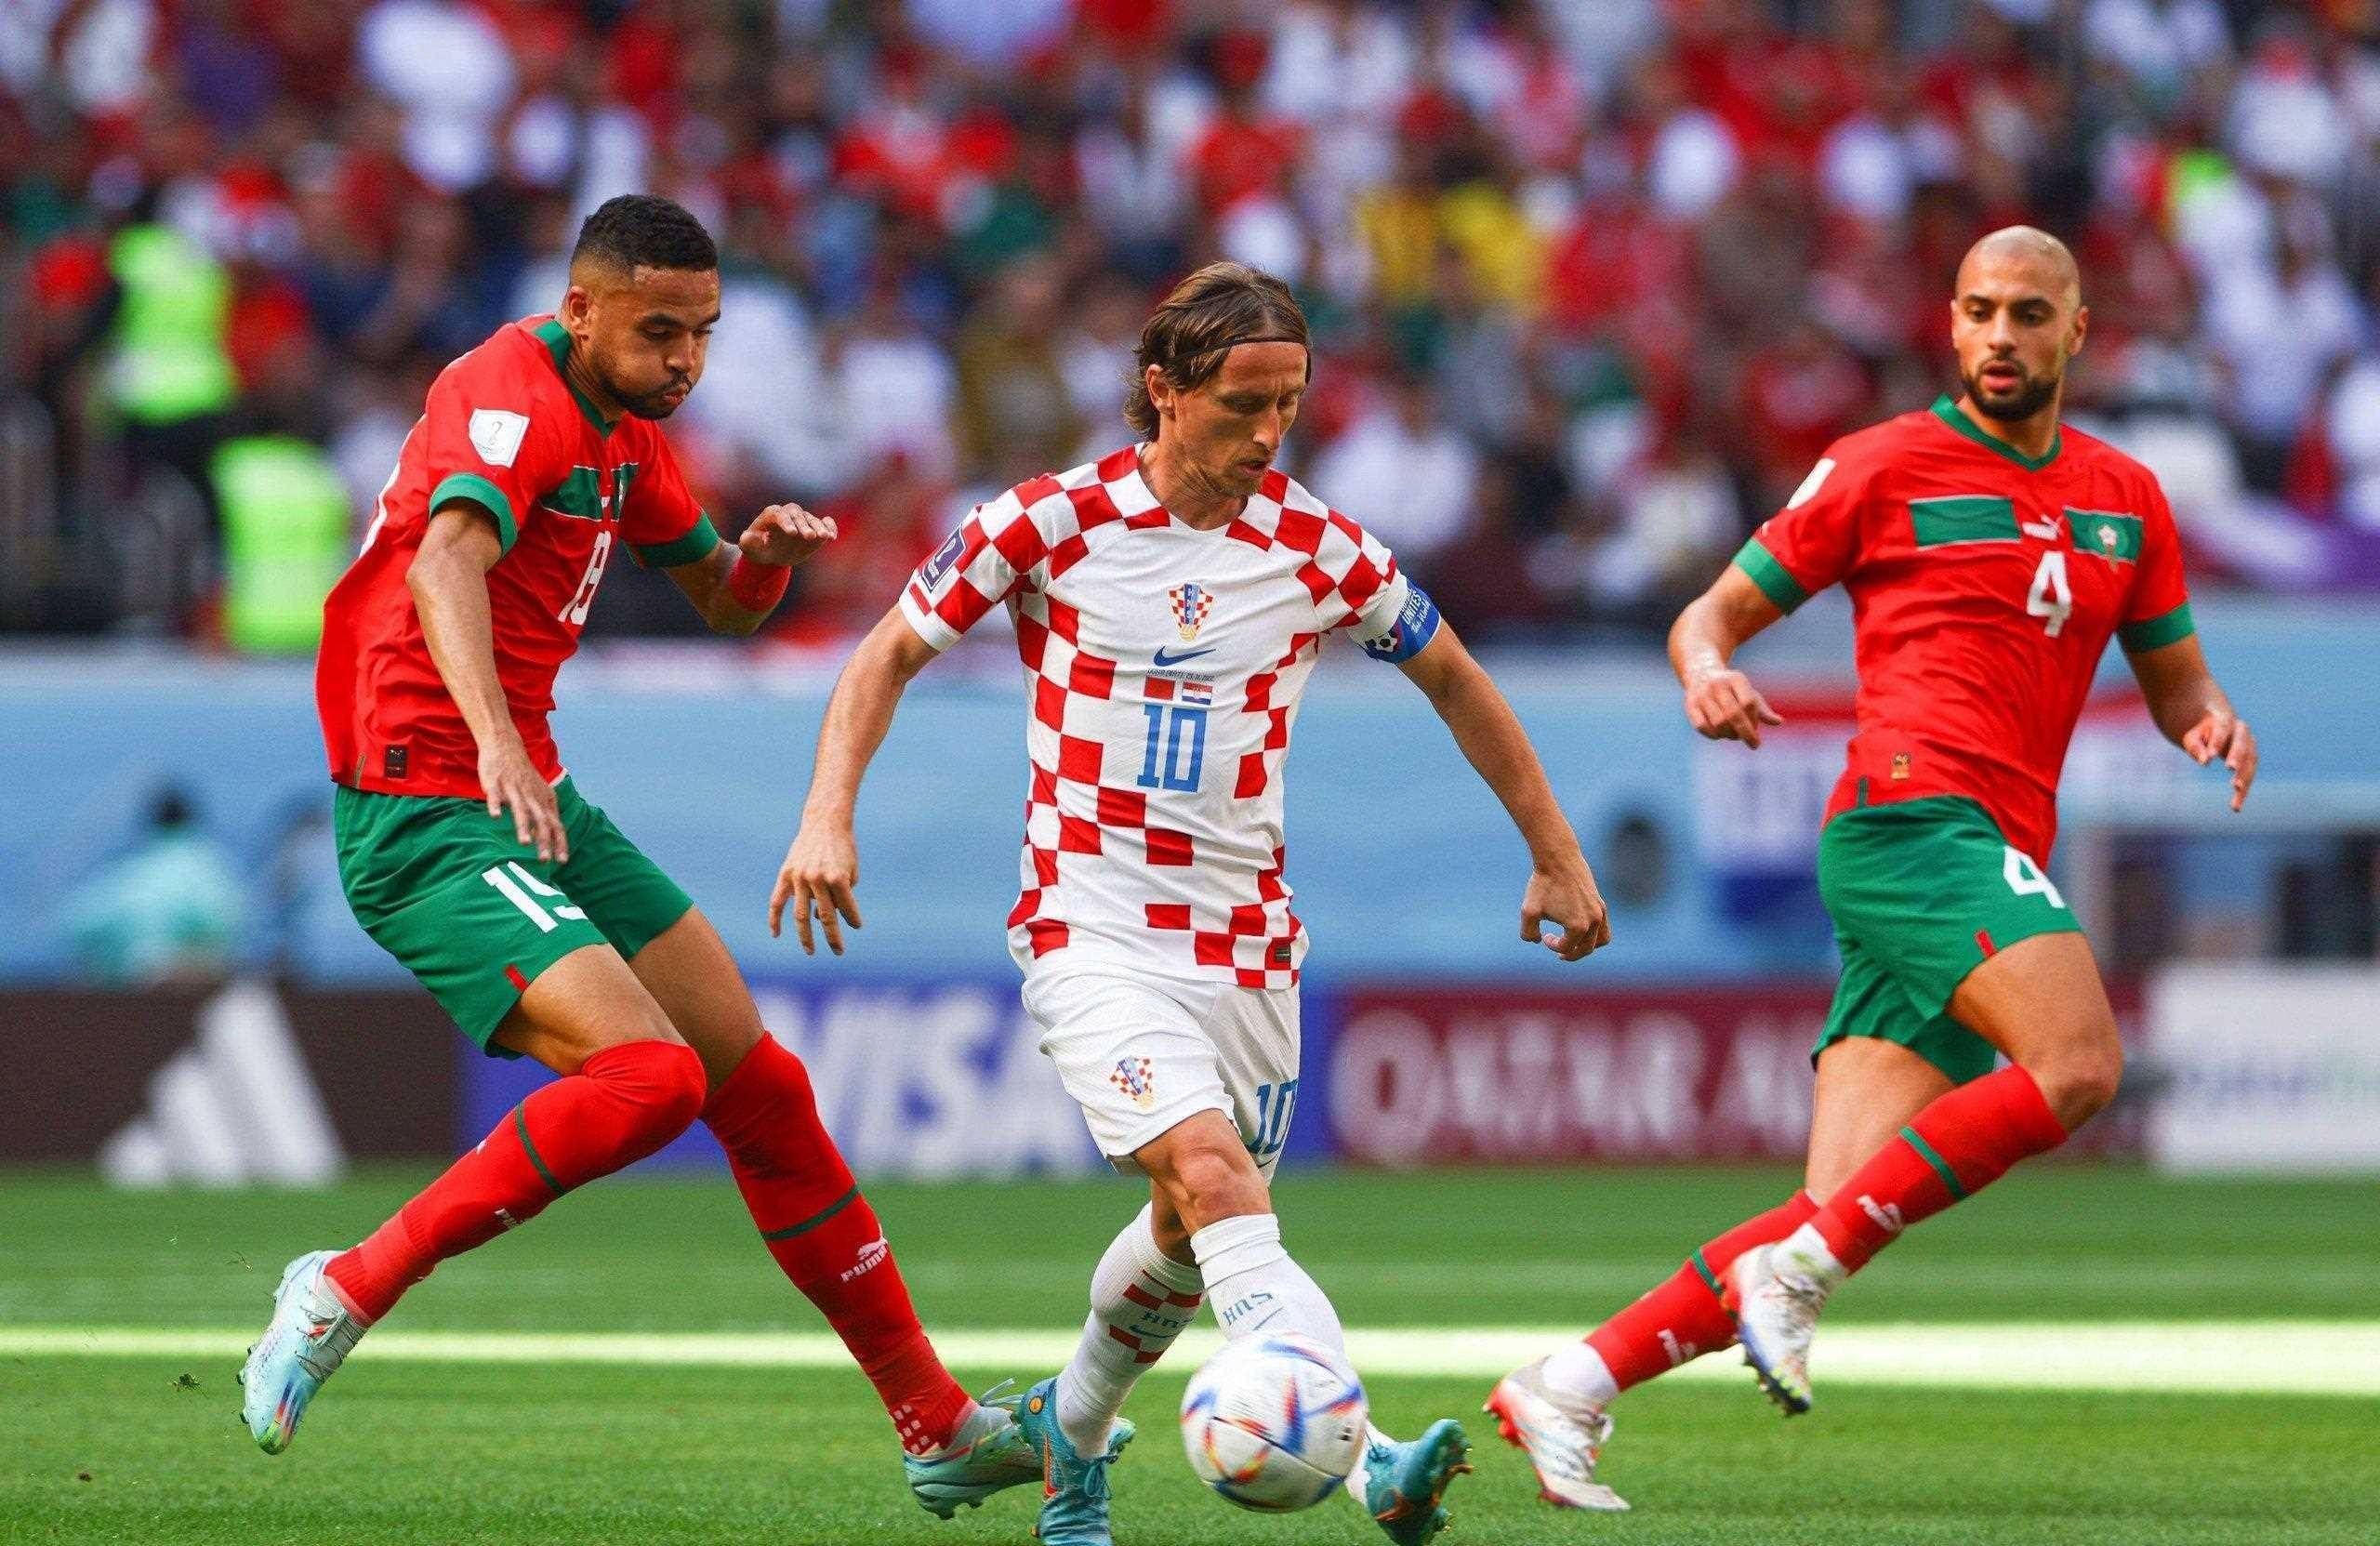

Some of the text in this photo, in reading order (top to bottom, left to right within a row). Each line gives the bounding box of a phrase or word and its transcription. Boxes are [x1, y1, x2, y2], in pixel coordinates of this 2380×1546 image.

[2027, 550, 2072, 638] 4
[1137, 704, 1207, 792] 10
[2003, 845, 2066, 909] 4
[1248, 1079, 1299, 1154] 10
[840, 1245, 888, 1282] PUMA
